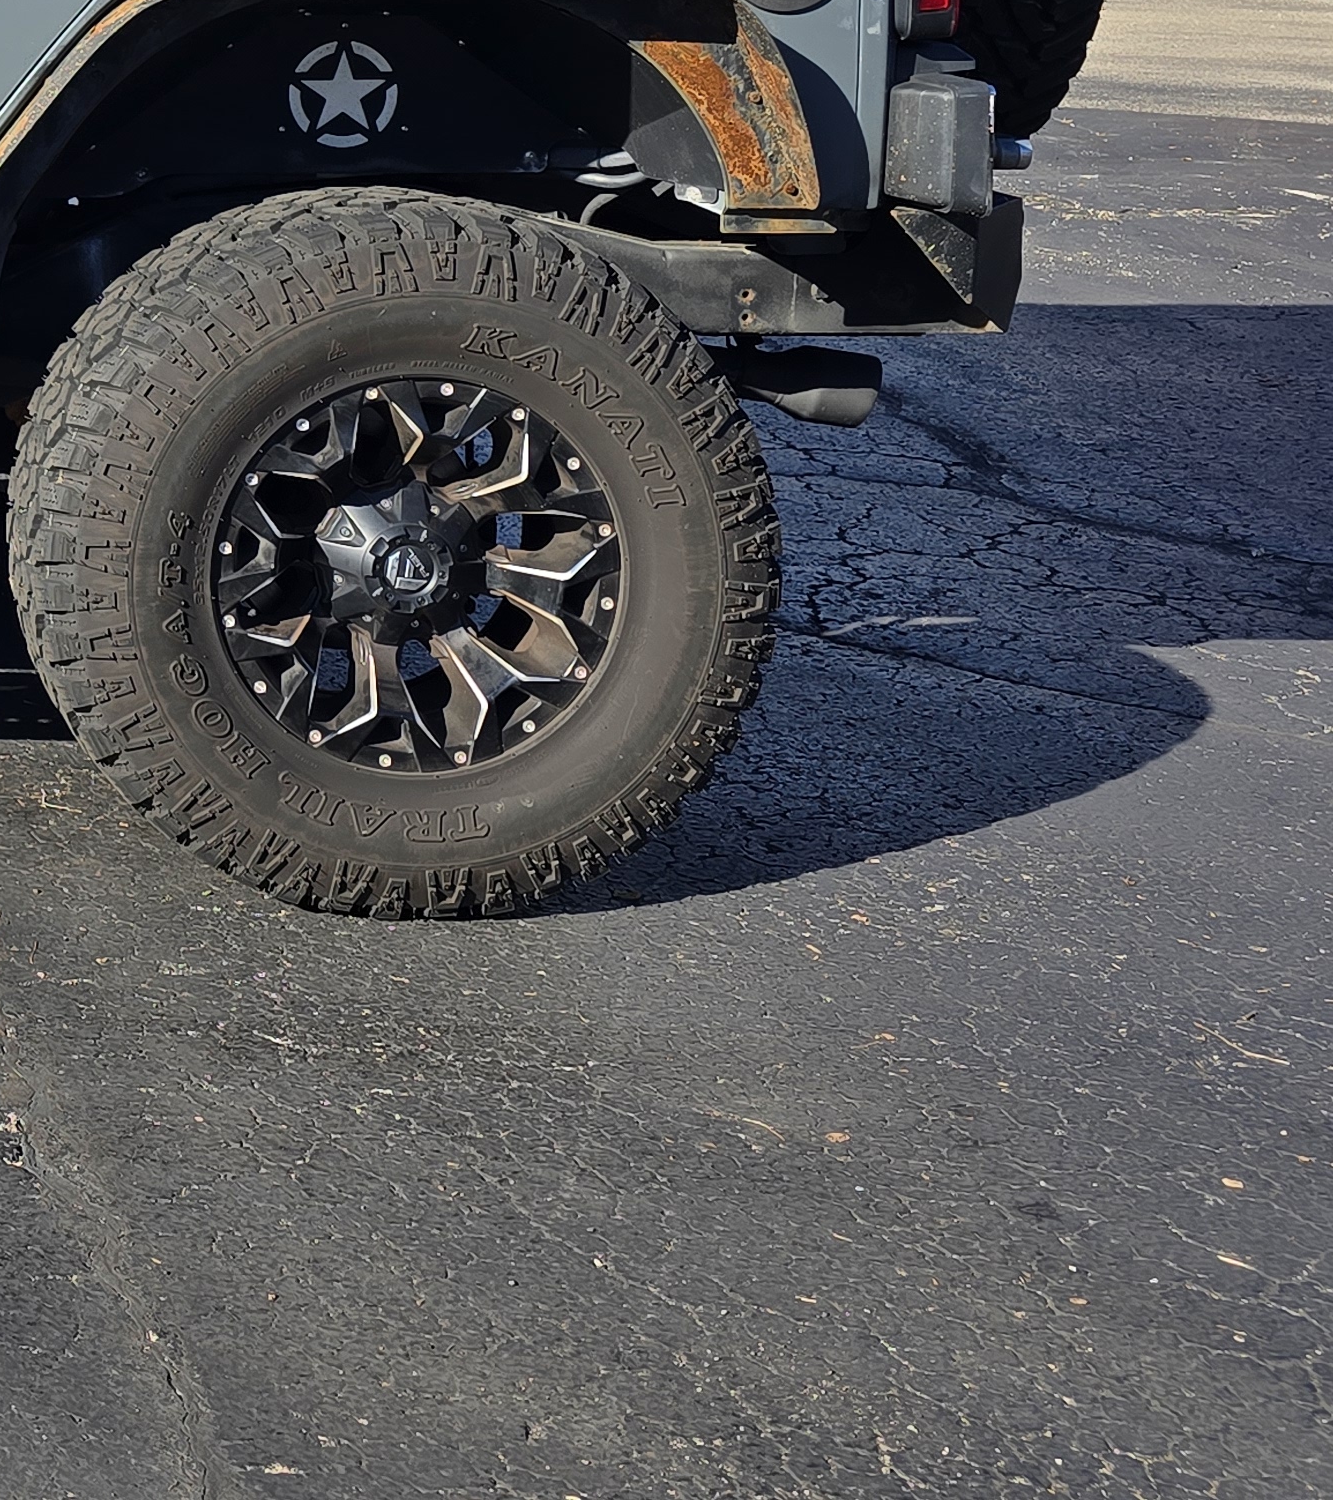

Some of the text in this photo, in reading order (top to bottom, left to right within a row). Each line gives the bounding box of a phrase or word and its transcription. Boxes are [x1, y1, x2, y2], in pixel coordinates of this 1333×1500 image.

[460, 323, 687, 510] KANATI
[407, 547, 430, 578] FUEL
[169, 653, 272, 780] HOG
[279, 770, 491, 843] TRAIL
